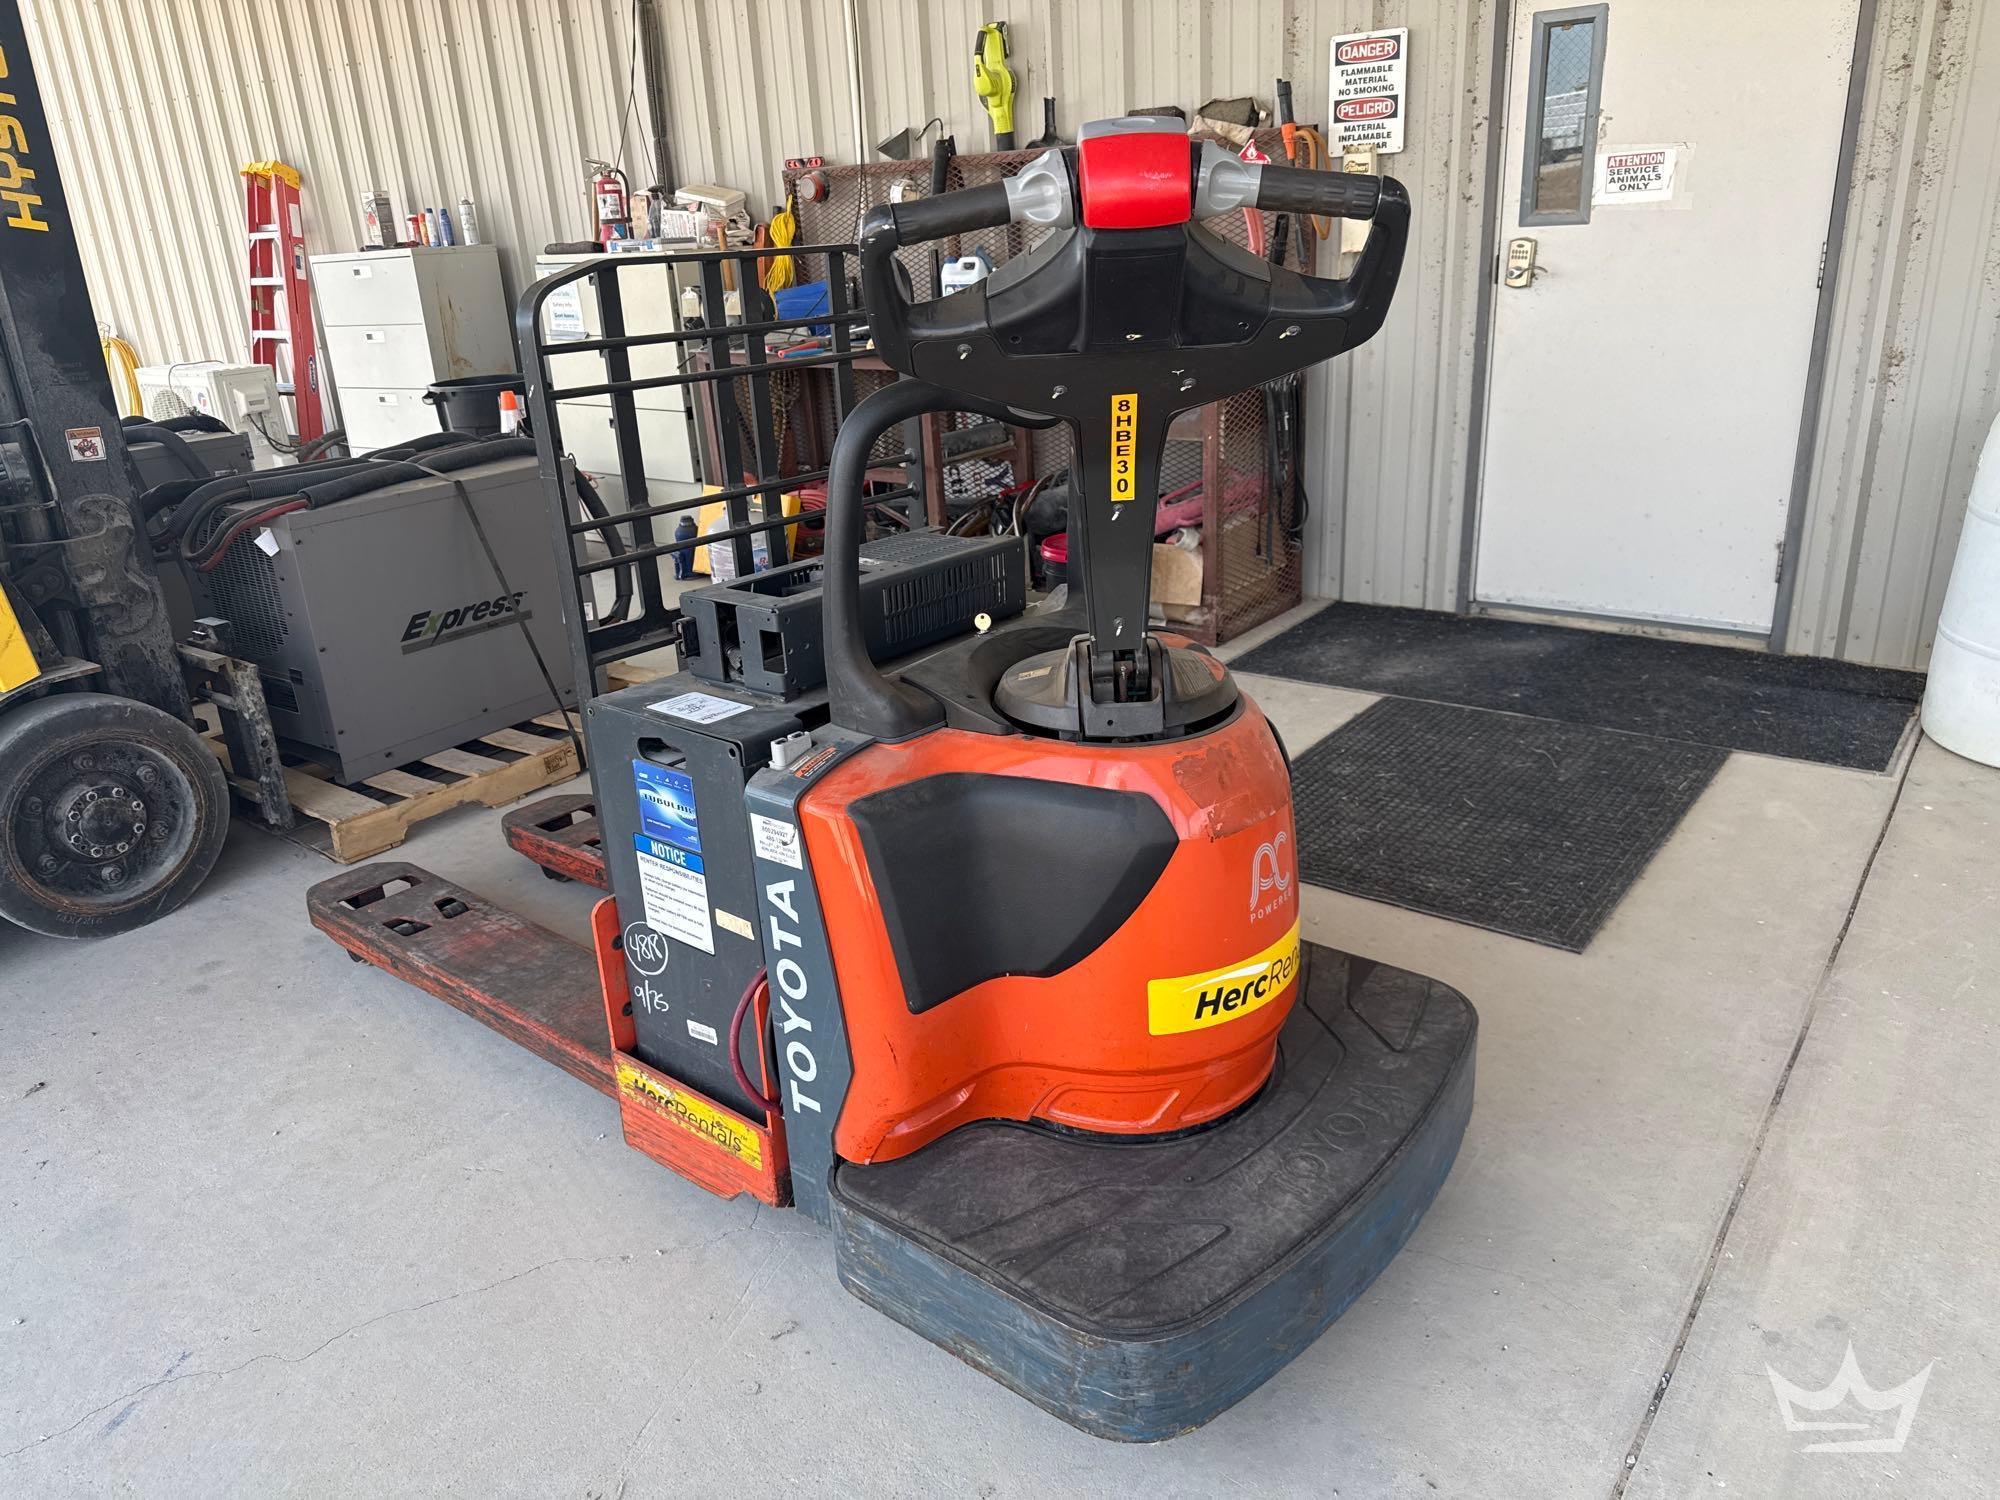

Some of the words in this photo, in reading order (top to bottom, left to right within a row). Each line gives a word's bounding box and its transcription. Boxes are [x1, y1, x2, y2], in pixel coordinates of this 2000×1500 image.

[1341, 42, 1394, 60] DANGER
[1340, 64, 1394, 77] FLAMMABLE
[1345, 75, 1388, 86] MATERIAL
[1353, 84, 1394, 95] SMOKING
[1340, 101, 1391, 117] PELIGRO
[1344, 122, 1386, 133] MATERIAL
[1338, 131, 1392, 143] INFLAMABLE
[1608, 152, 1664, 168] ATTENTION
[1608, 165, 1659, 176] SERVICE
[1608, 173, 1662, 184] ANIMALS
[1618, 182, 1650, 191] ONLY
[1116, 399, 1132, 493] 8HBE30
[650, 839, 687, 867] NOTICE
[659, 861, 704, 886] RESPONSIBILITIES
[1194, 936, 1300, 1020] HercRen
[765, 879, 822, 1114] TOYOTA
